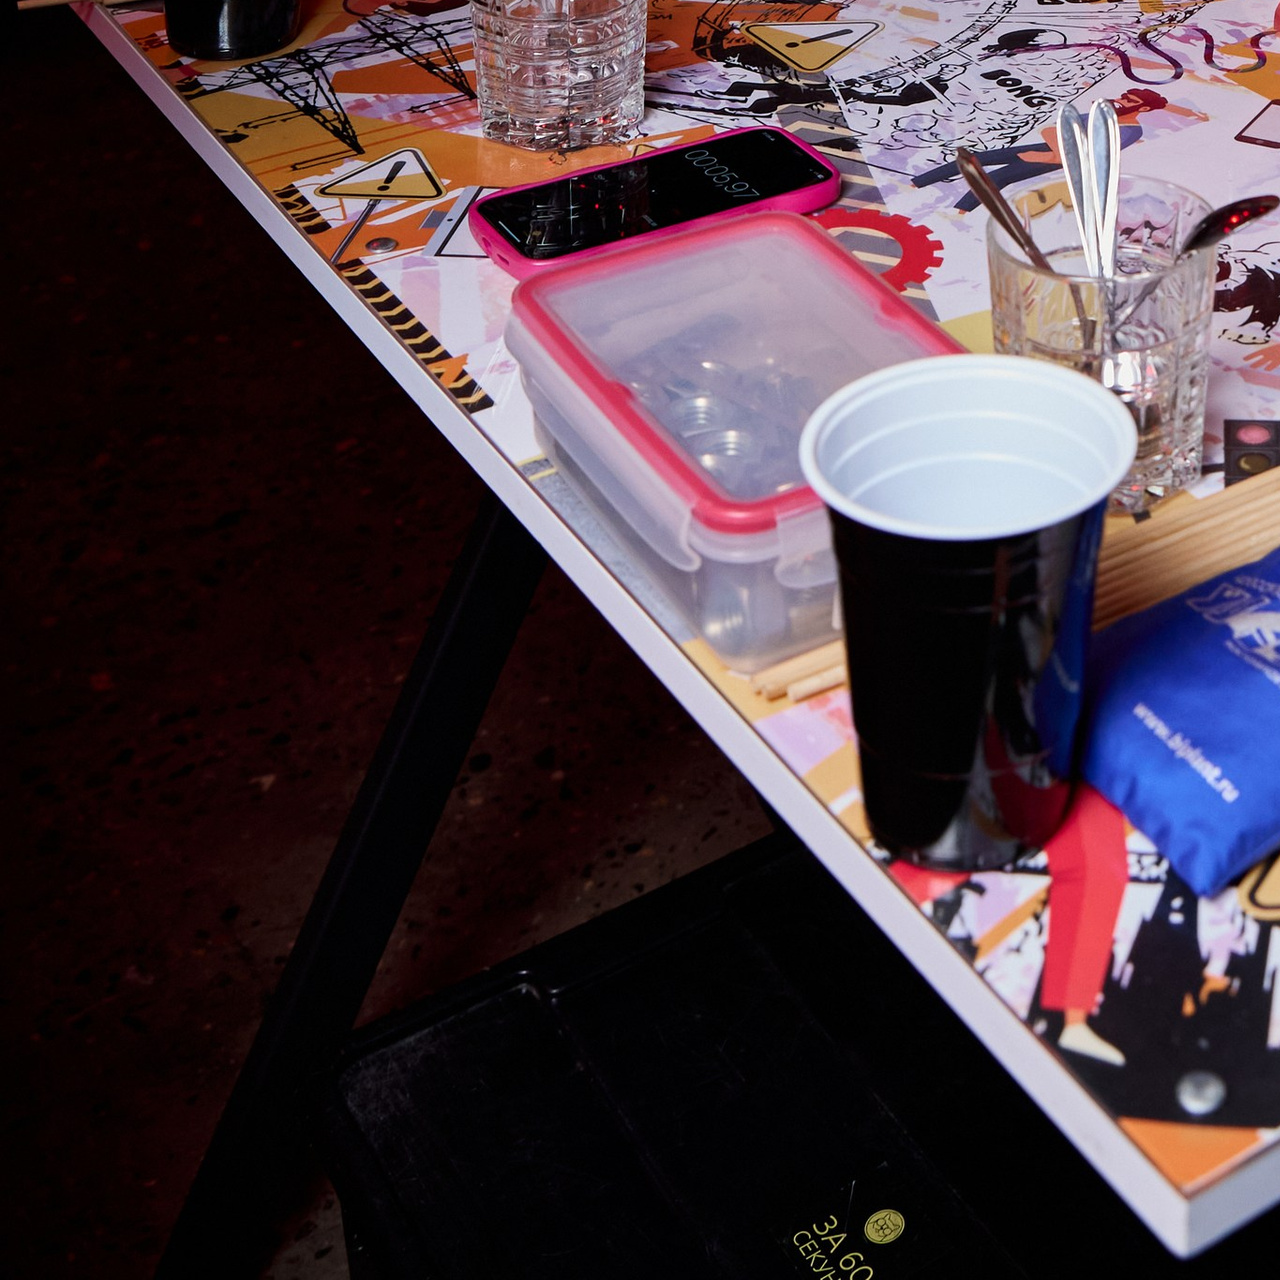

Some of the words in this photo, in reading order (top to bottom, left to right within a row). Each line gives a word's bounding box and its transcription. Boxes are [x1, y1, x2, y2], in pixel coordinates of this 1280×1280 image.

[979, 69, 1057, 109] BONG
[684, 149, 761, 198] 00:05,97
[813, 1215, 847, 1254] ЗА
